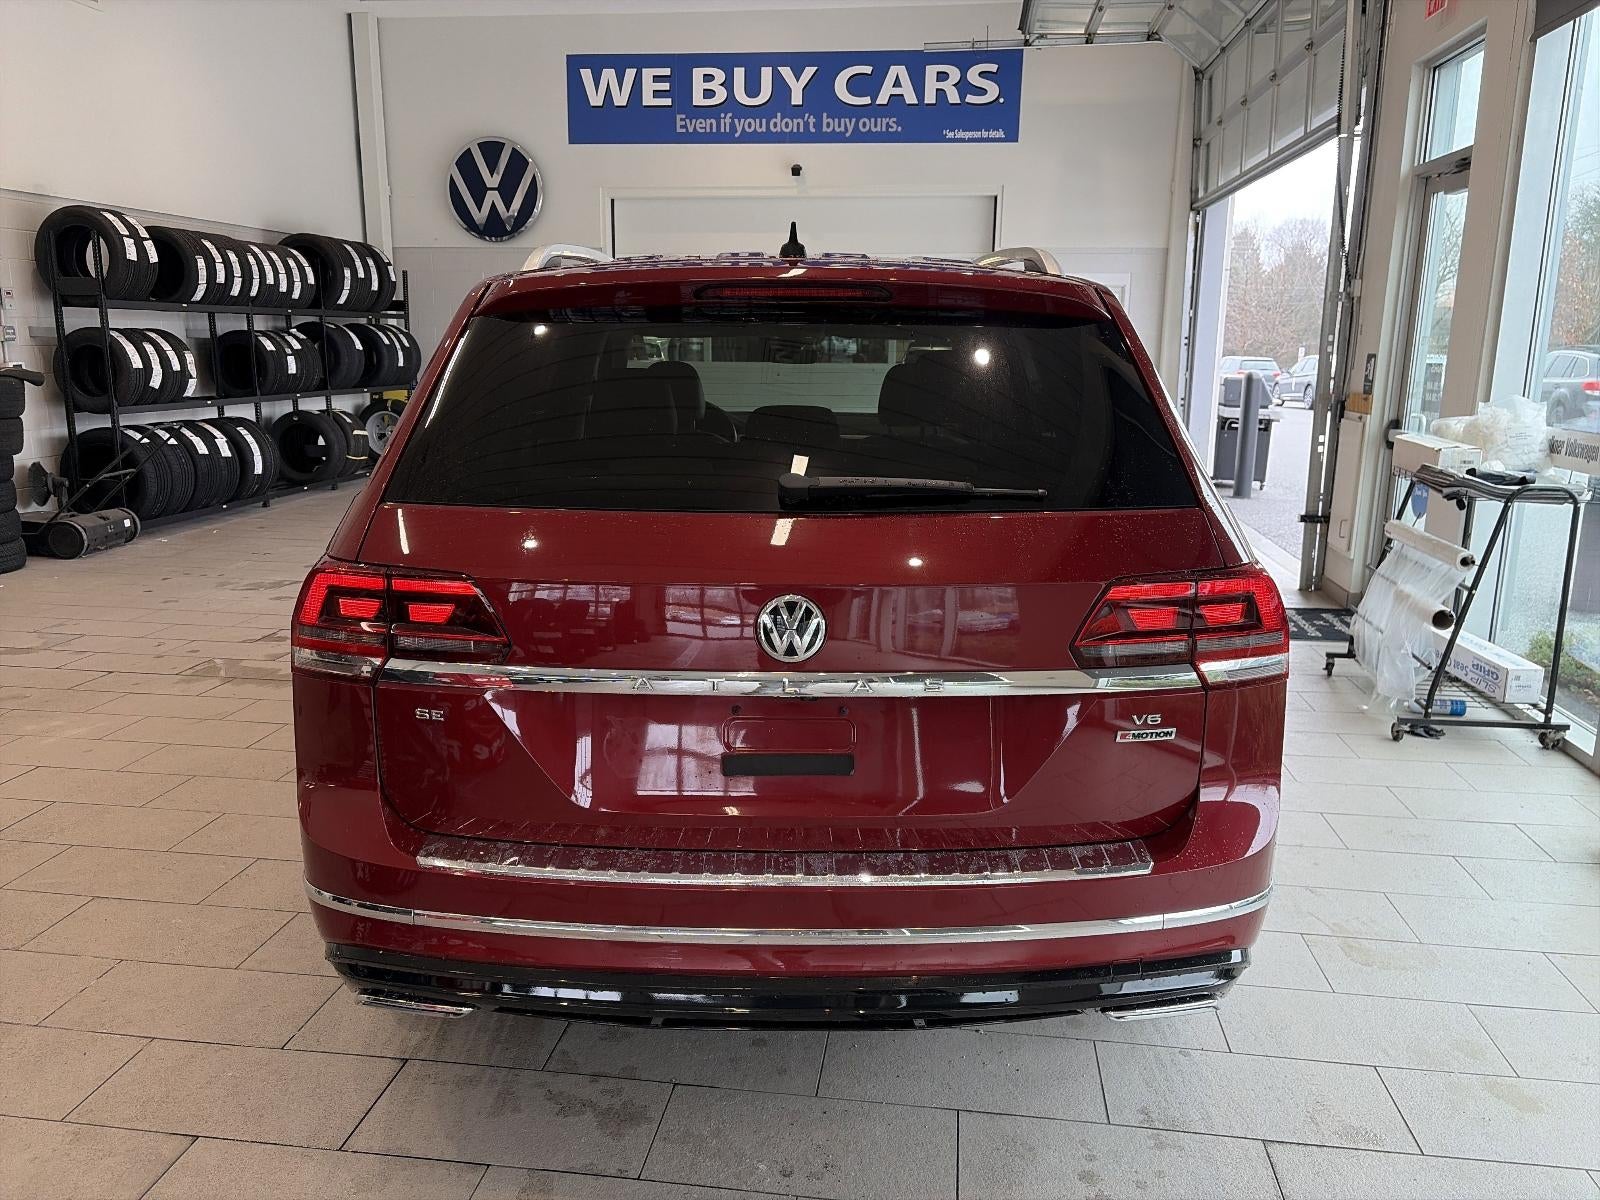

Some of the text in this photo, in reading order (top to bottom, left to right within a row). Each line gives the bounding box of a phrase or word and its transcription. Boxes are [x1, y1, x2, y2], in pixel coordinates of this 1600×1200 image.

[580, 63, 1005, 107] WE BUY CARS.
[676, 112, 902, 138] Even if you don't buy ours.
[955, 129, 982, 140] Salesperson
[447, 136, 543, 242] VW
[757, 594, 826, 663] VW
[1472, 662, 1499, 681] GRIP
[632, 677, 944, 693] ATLAS
[1470, 676, 1497, 694] SLIP
[415, 708, 445, 721] SE
[1132, 713, 1162, 726] V6
